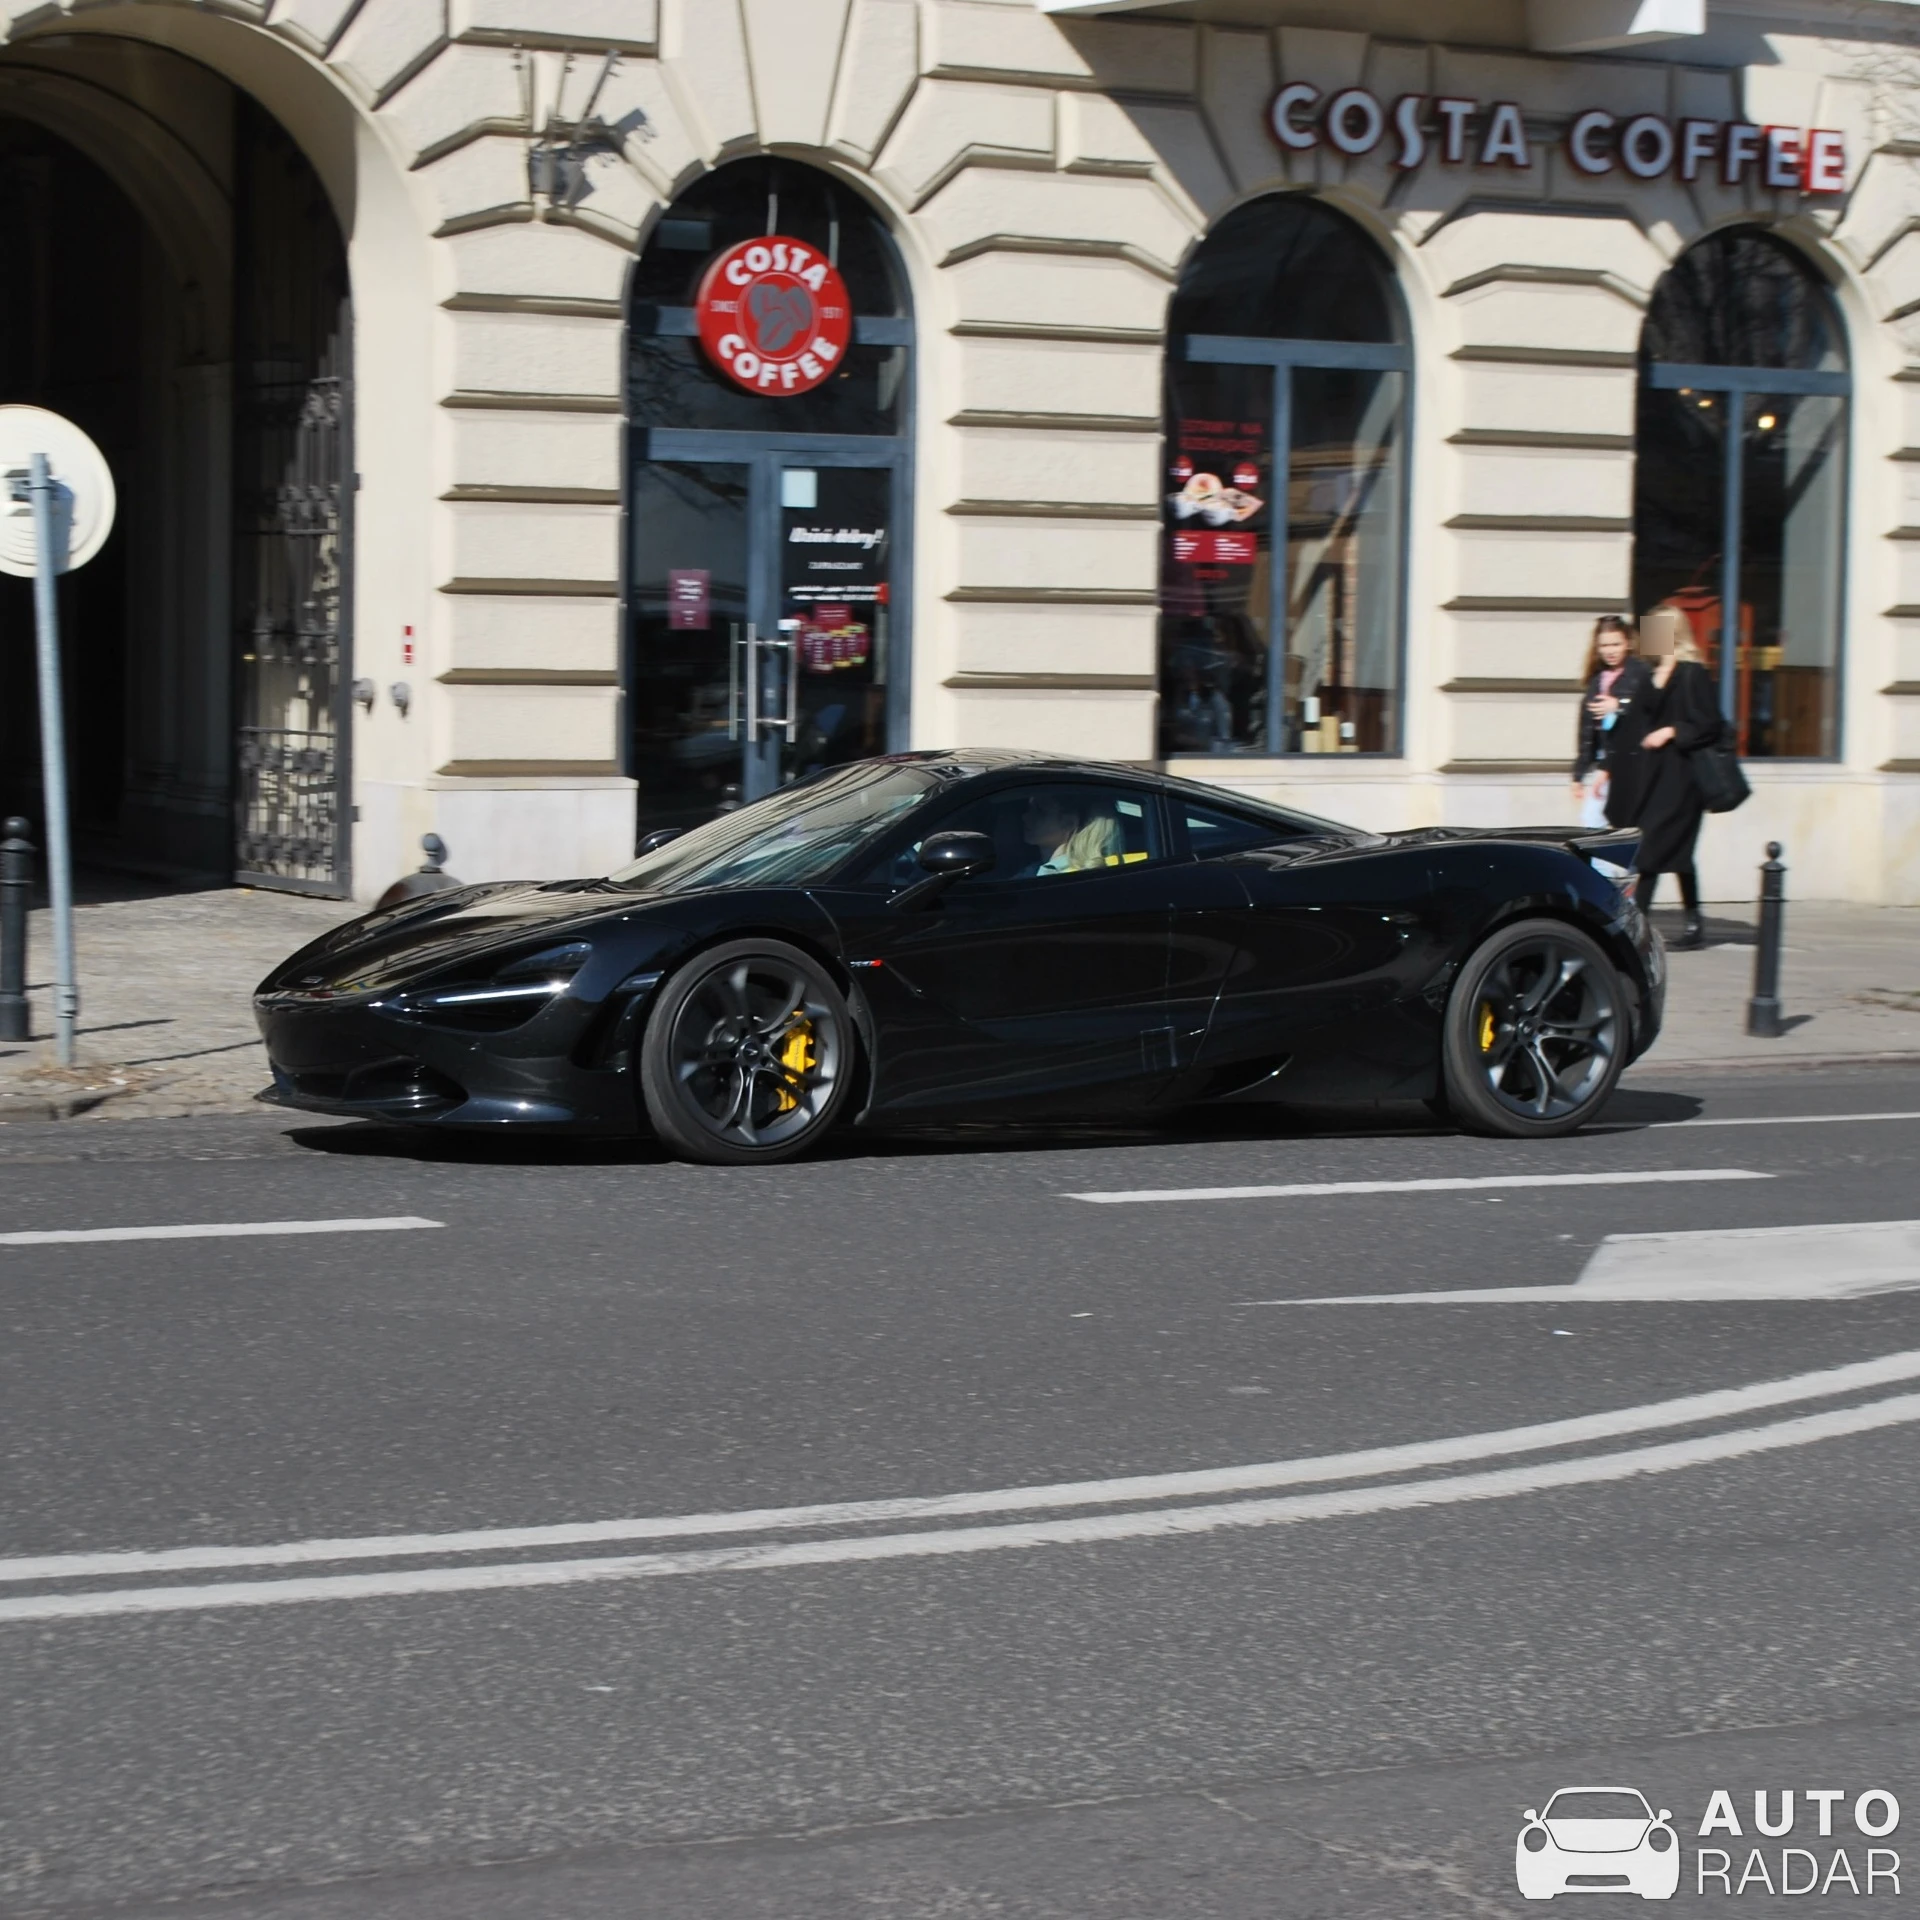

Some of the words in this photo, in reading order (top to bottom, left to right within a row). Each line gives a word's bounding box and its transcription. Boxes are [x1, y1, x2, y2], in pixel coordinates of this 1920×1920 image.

[1269, 82, 1531, 170] COSTA
[1567, 109, 1845, 192] COFFEE
[725, 243, 828, 292] COSTA
[717, 333, 839, 389] COFFEE
